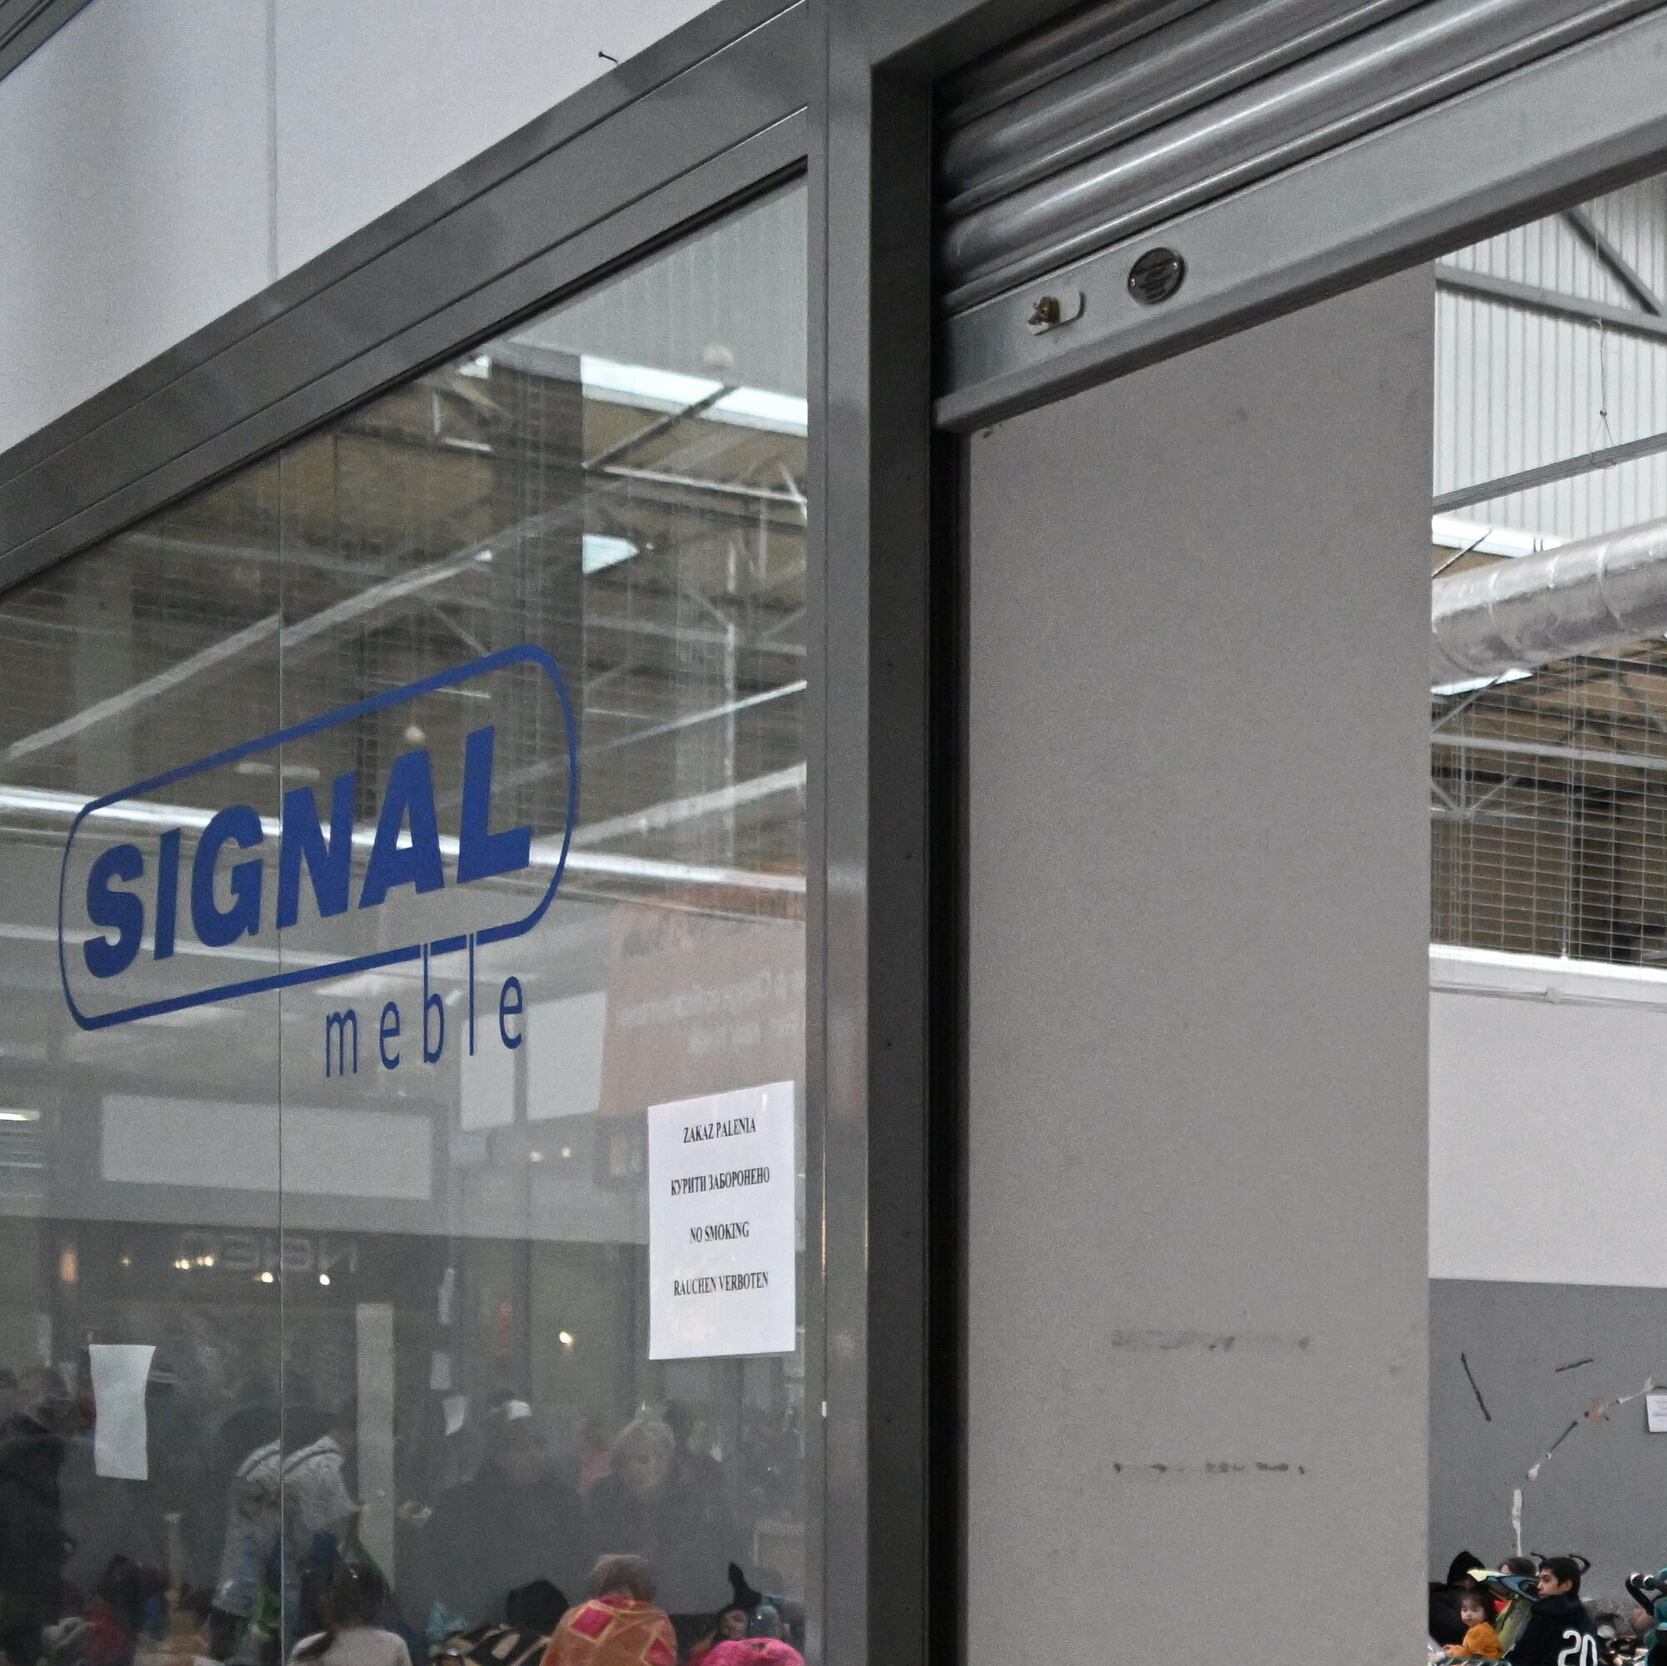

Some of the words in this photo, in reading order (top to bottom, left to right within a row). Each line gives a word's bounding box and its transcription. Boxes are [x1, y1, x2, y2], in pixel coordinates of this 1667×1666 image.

[84, 726, 531, 978] SIGNAL
[326, 933, 524, 1077] meble
[683, 1123, 714, 1143] ZAKAZ
[716, 1117, 756, 1138] PALENIA
[671, 1176, 706, 1196] КУРИТИ
[709, 1166, 770, 1190] ЗАБОРОНЕНО
[690, 1226, 702, 1244] NO
[704, 1221, 750, 1242] SMOKING
[674, 1276, 716, 1296] RAUCHEN
[718, 1272, 768, 1291] VERBOTEN
